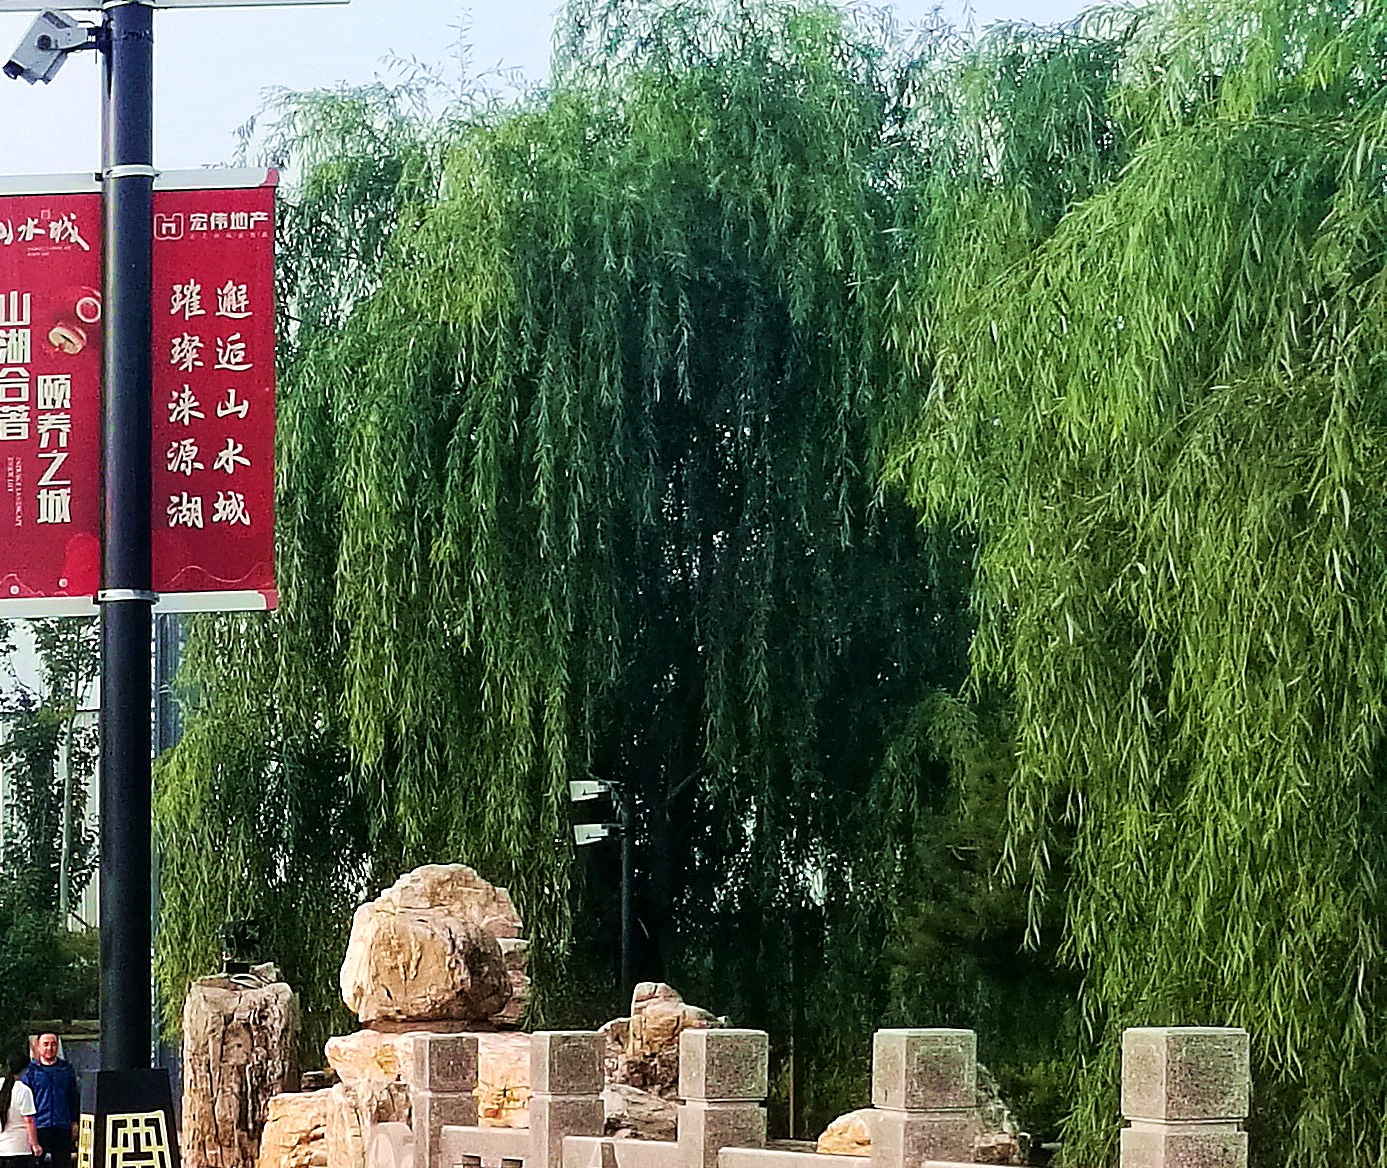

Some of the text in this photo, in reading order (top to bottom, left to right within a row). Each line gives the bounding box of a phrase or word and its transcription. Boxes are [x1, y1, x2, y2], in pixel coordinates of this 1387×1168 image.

[189, 211, 269, 231] 宏伟地产
[37, 373, 72, 524] 颐养之城
[167, 278, 206, 529] 璀璨涞源湖
[212, 279, 254, 527] 邂逅山水城
